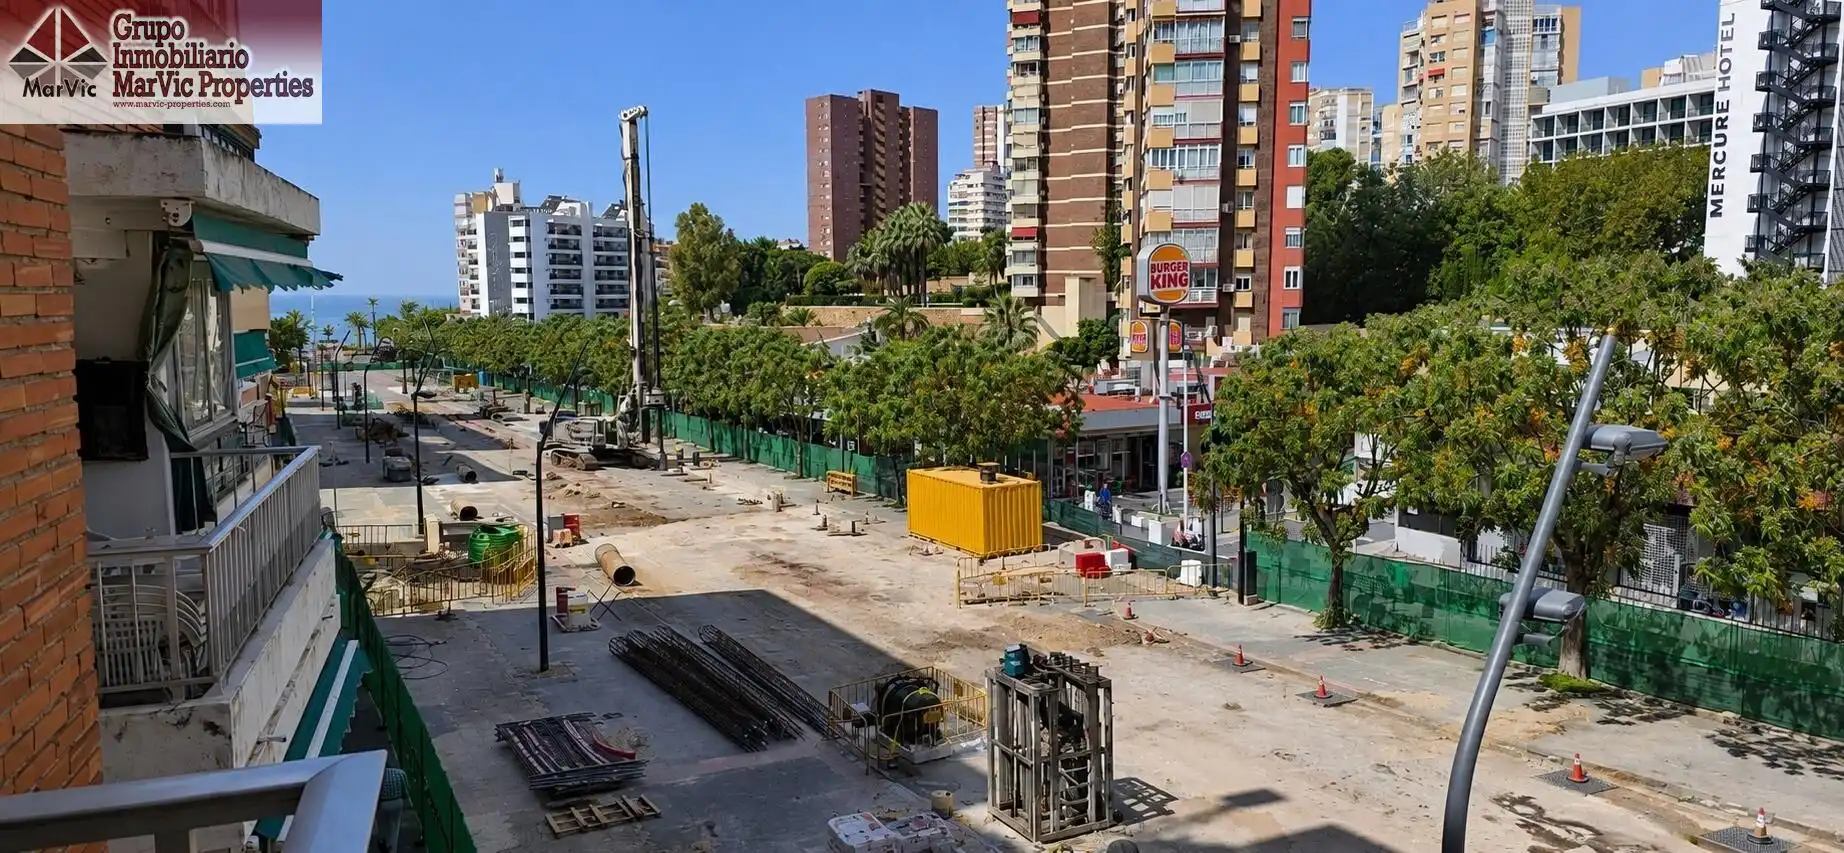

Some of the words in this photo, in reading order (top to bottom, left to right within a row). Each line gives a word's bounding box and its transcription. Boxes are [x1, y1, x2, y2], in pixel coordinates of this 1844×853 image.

[1717, 12, 1735, 92] HOTEL
[1709, 100, 1730, 218] MERCURE
[1150, 261, 1189, 274] BURGER
[1150, 273, 1189, 289] KING
